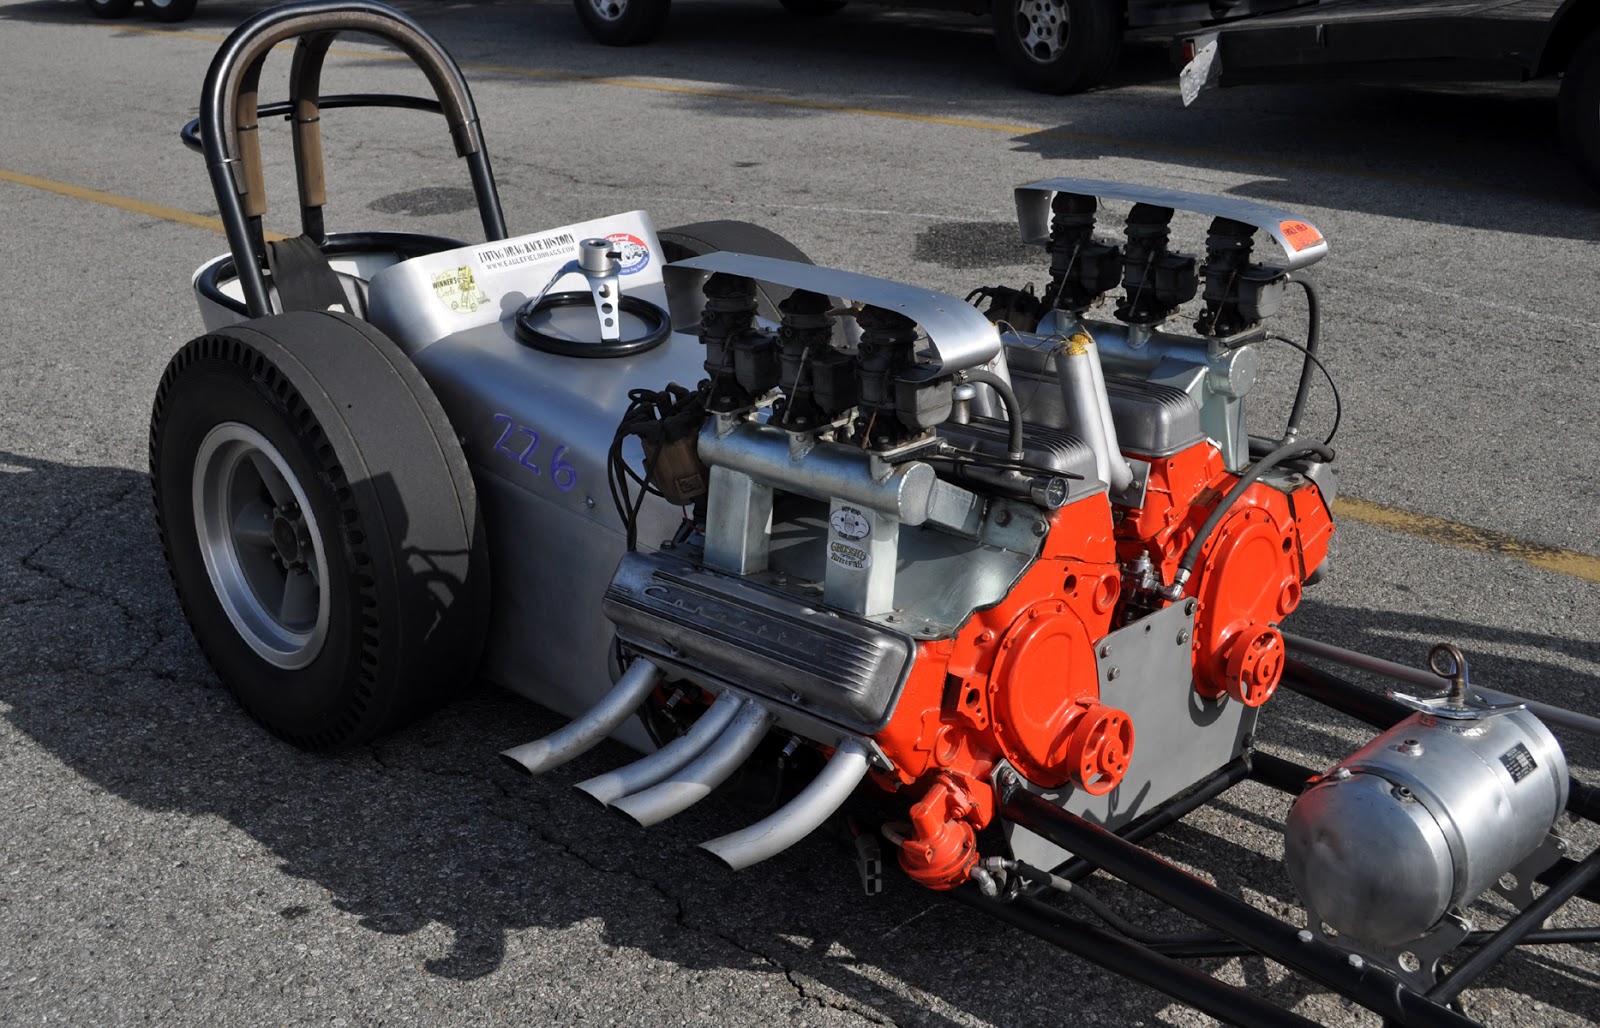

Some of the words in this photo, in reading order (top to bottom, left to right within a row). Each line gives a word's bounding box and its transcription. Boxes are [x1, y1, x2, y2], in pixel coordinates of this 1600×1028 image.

[478, 248, 504, 263] LIVING
[504, 244, 525, 258] DRAG
[523, 239, 543, 253] RACE
[542, 233, 575, 249] HISTORY
[494, 413, 577, 493] 226
